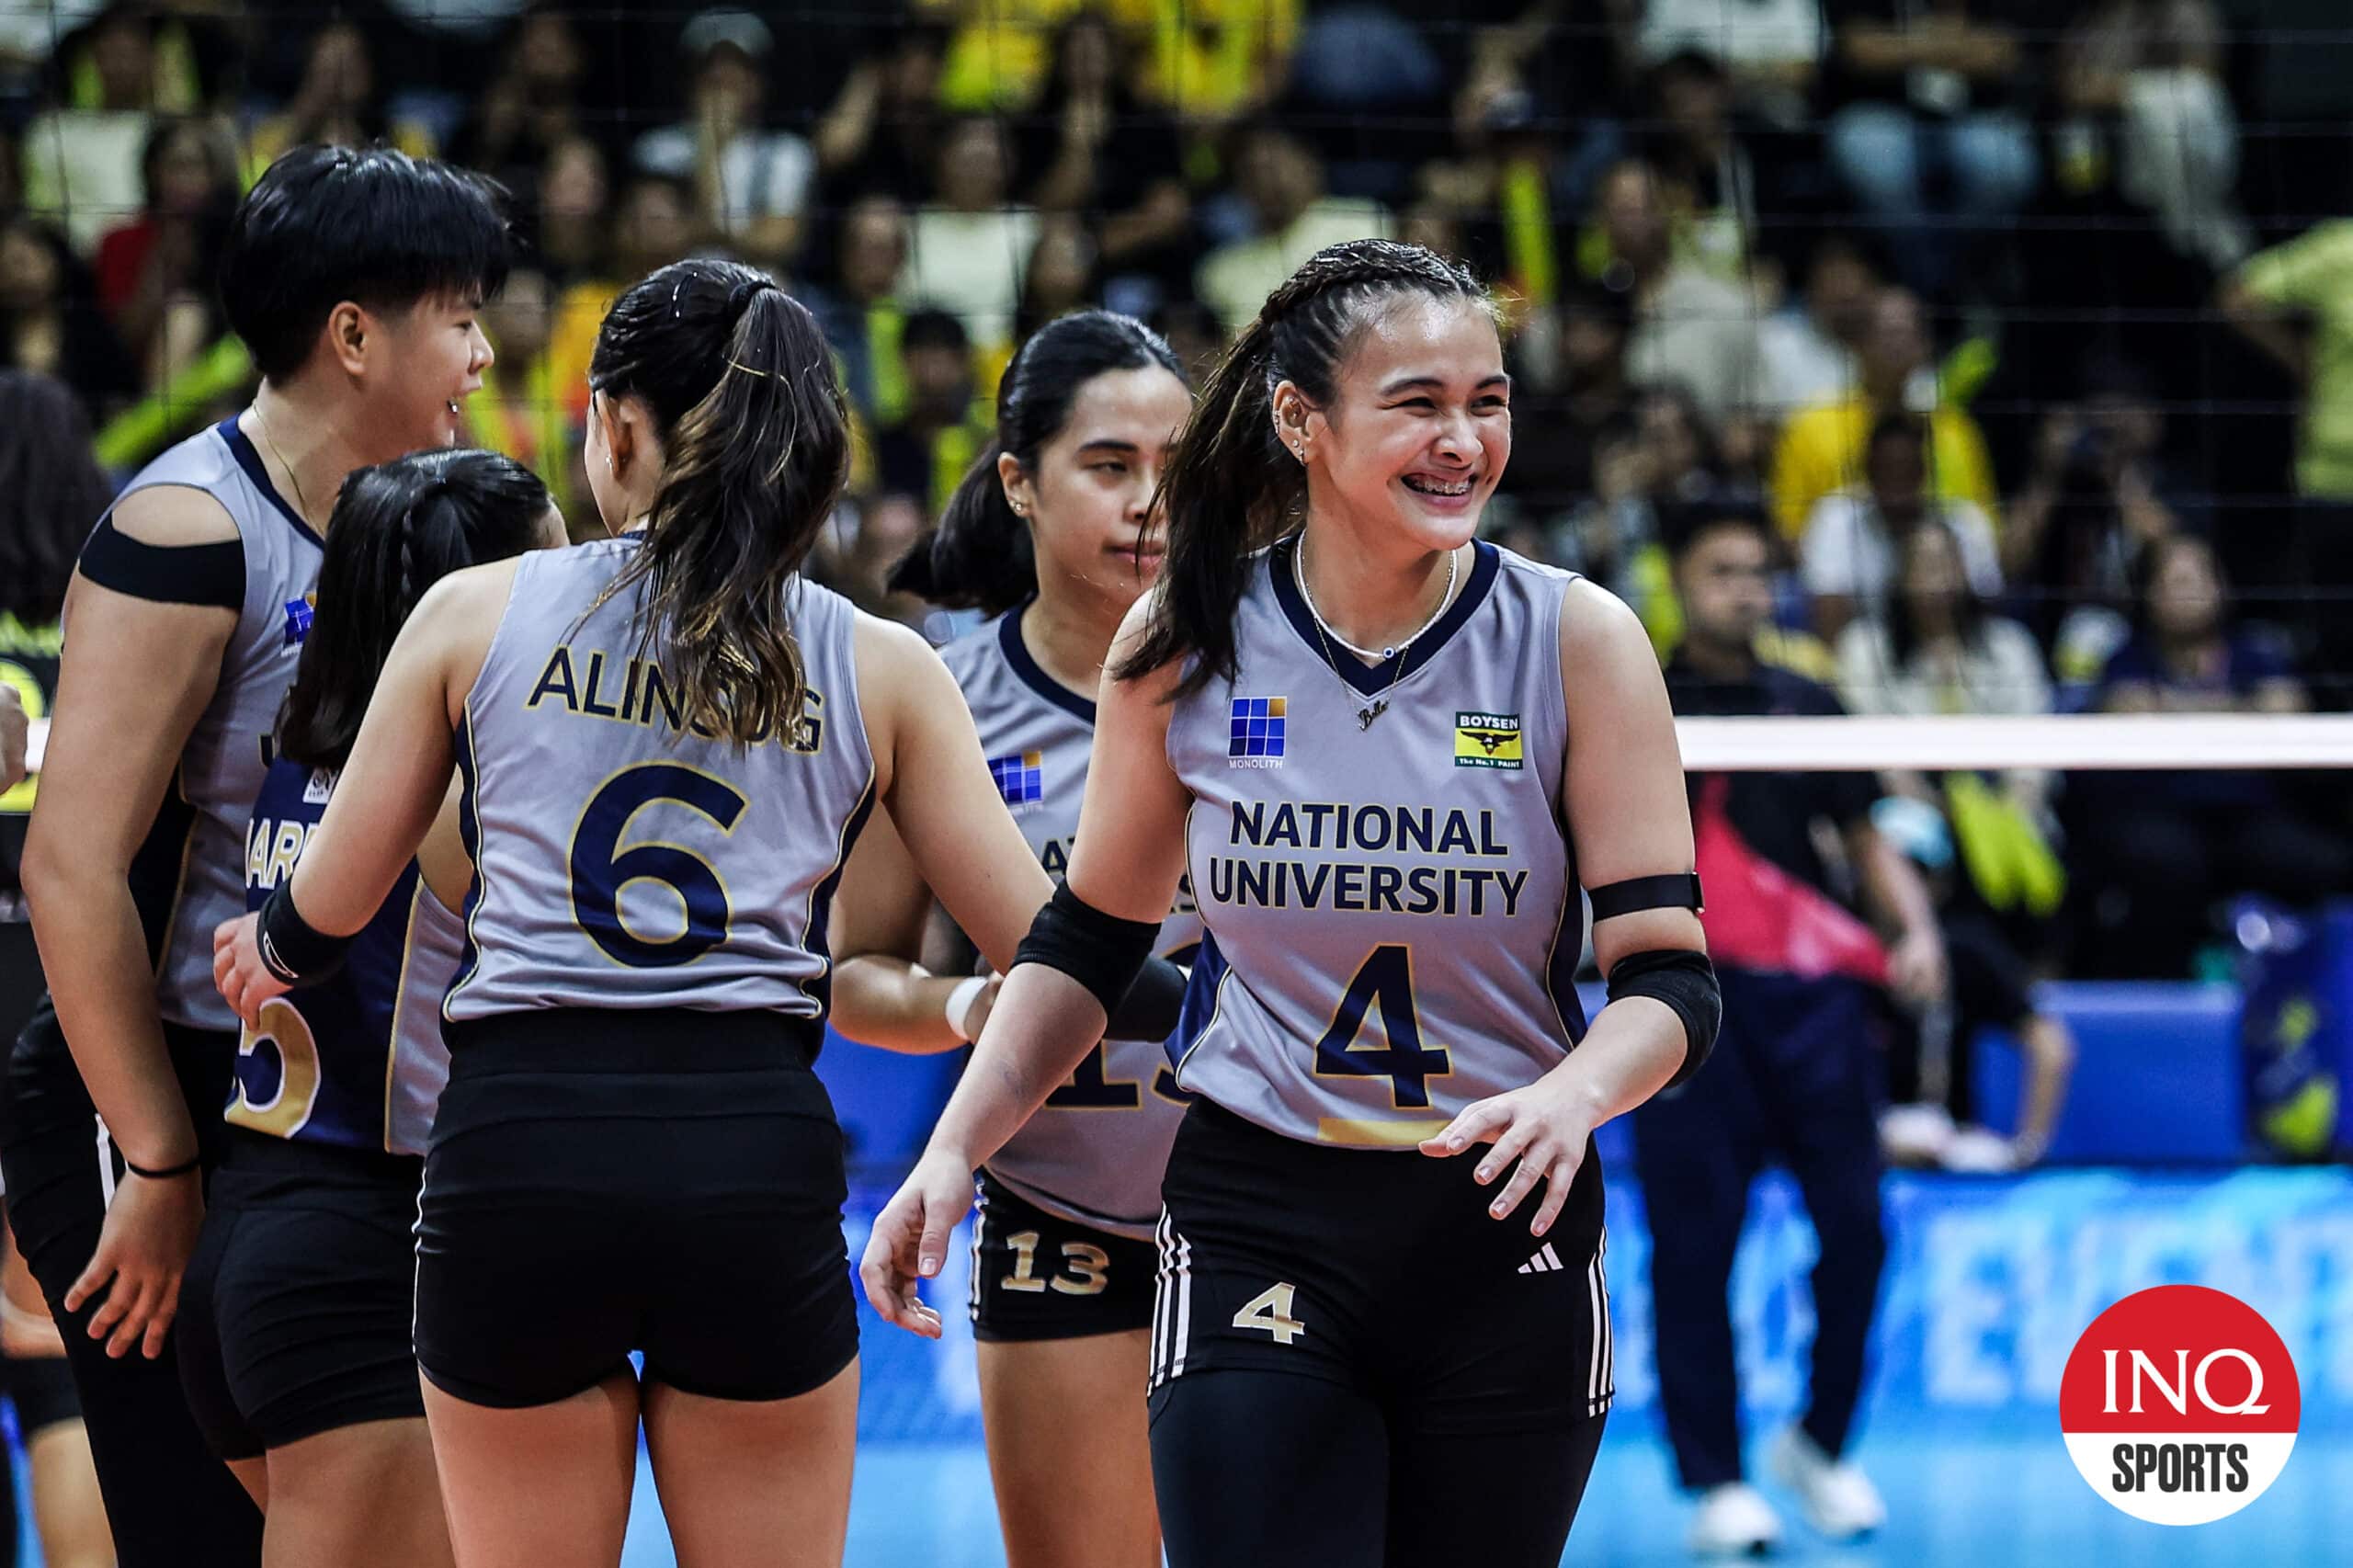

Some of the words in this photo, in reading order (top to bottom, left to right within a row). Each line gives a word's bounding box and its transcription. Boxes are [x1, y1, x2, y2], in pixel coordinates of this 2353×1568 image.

[523, 646, 824, 756] ALING
[1460, 715, 1518, 730] BOYSEN
[1228, 759, 1283, 769] MONOLITH
[1229, 801, 1510, 857] NATIONAL
[567, 760, 750, 970] 6
[1209, 856, 1531, 917] UNIVERSITY
[1313, 942, 1454, 1110] 4
[1001, 1231, 1109, 1295] 13
[1233, 1281, 1305, 1345] 4
